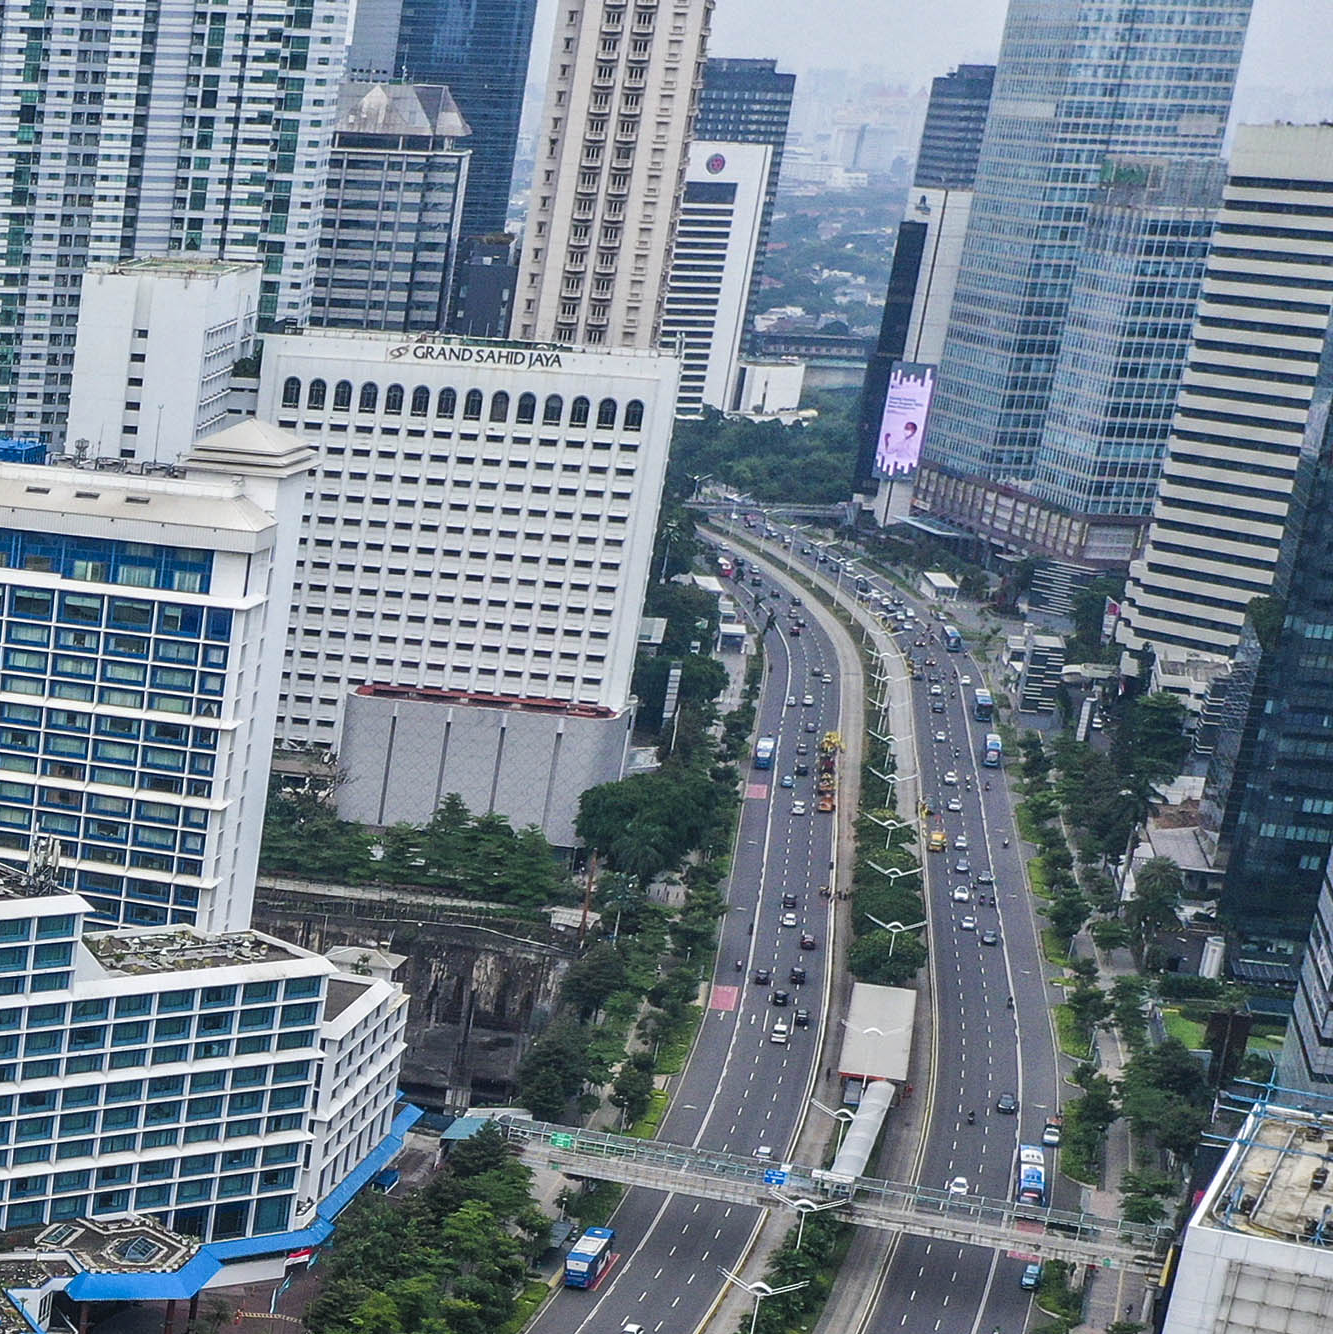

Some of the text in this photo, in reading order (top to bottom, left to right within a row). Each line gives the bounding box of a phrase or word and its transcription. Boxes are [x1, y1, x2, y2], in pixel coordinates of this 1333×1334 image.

[413, 346, 562, 369] GRAND SAHID JAYA
